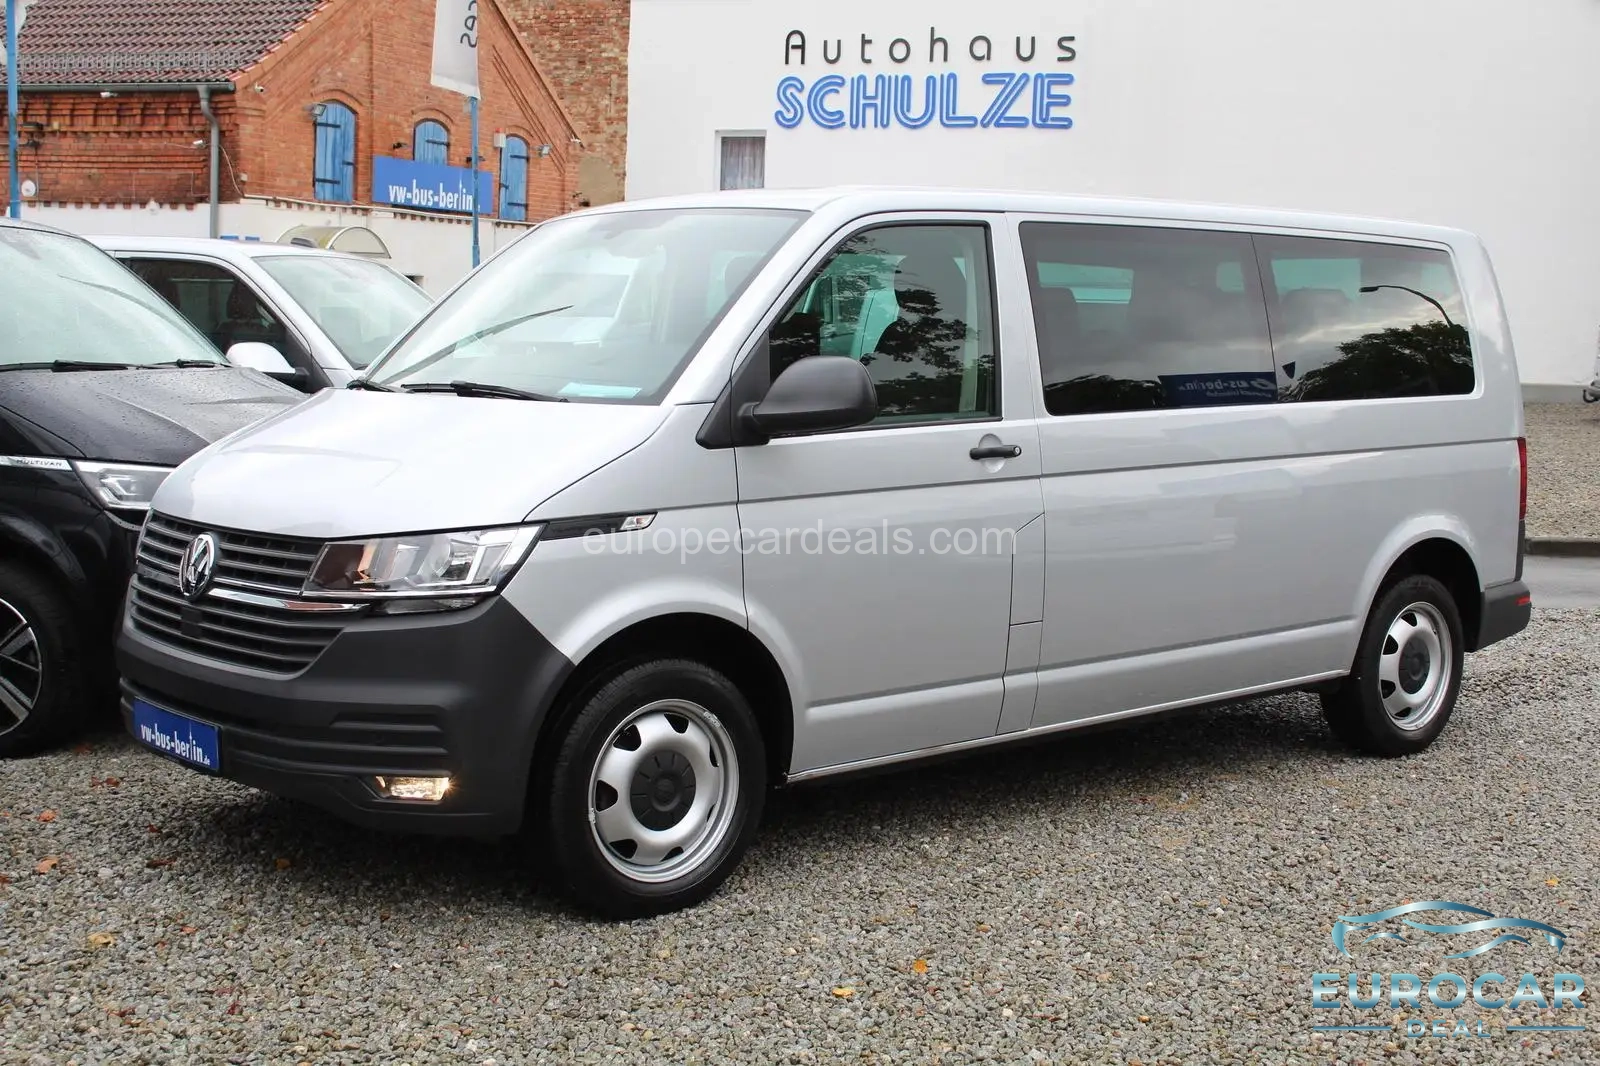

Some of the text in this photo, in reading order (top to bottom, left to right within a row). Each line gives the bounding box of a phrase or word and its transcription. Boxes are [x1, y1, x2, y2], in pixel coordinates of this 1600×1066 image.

[785, 26, 1076, 65] Autohaus
[774, 72, 1075, 130] SCHULZE
[388, 176, 481, 212] vw-bus-berlin
[16, 459, 63, 467] MULTIVAN
